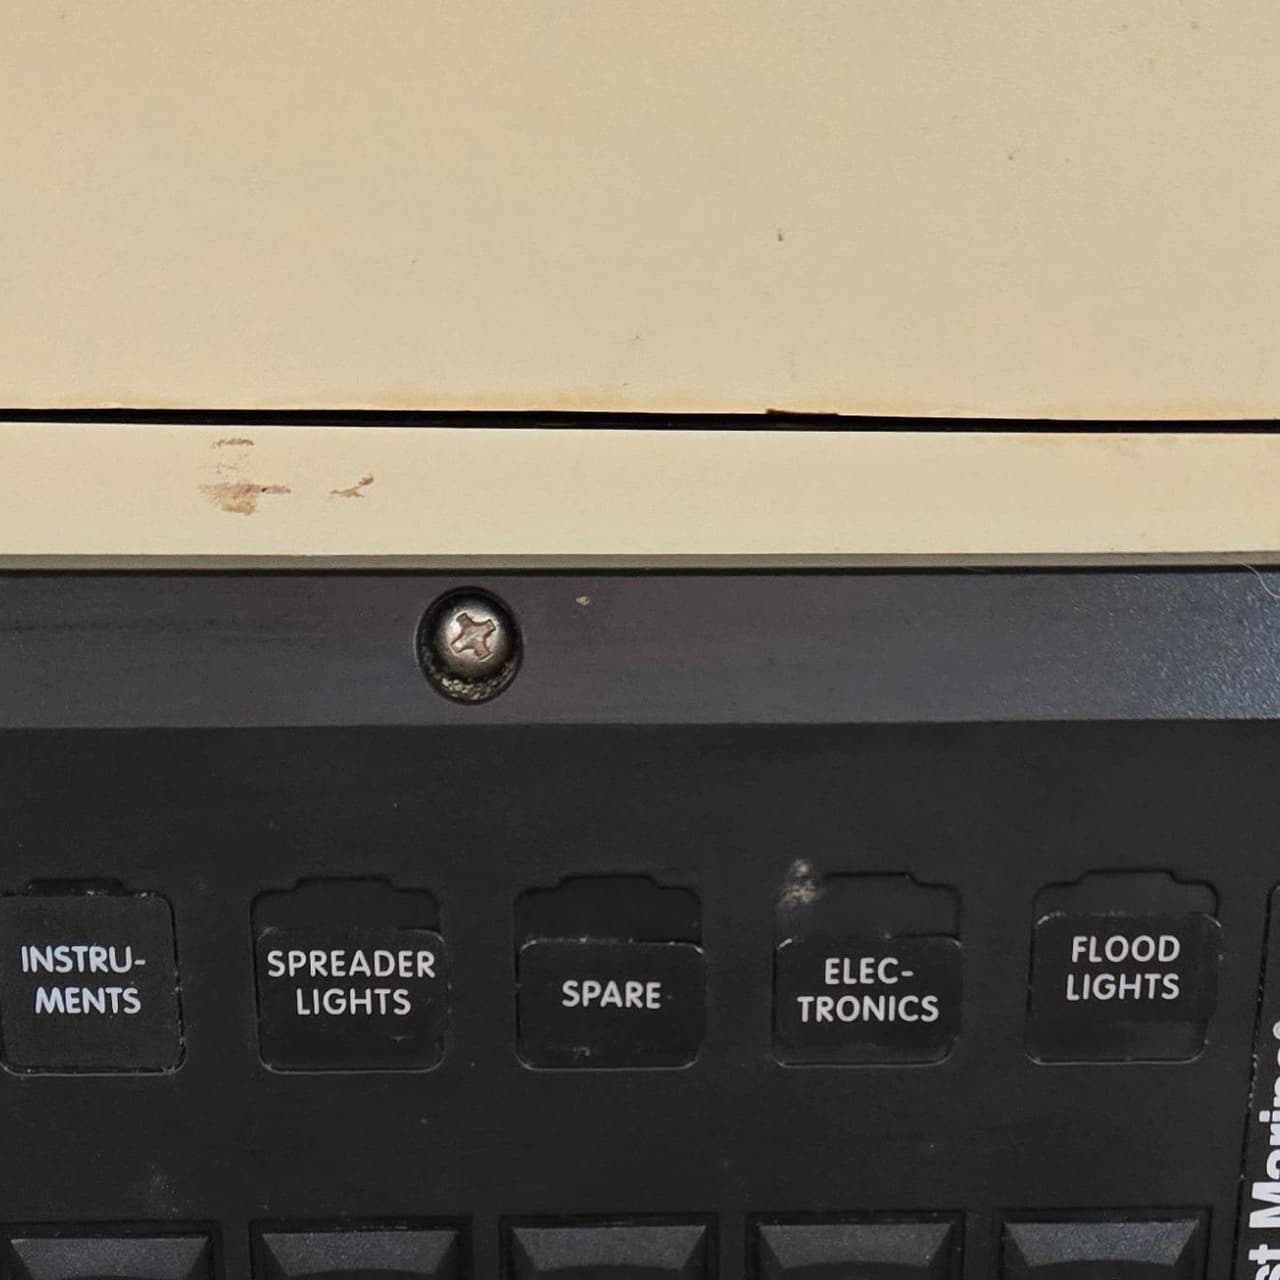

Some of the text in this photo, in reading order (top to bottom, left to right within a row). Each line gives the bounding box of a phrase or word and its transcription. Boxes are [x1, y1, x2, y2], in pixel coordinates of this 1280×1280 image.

[20, 945, 146, 974] INSTRU-
[267, 949, 436, 978] SPREADER
[1071, 935, 1180, 963] FLOOD
[824, 957, 914, 985] ELEC-
[35, 986, 141, 1014] MENTS
[296, 987, 412, 1016] LIGHTS
[562, 980, 661, 1009] SPARE
[1066, 972, 1180, 1002] LIGHTS
[797, 995, 939, 1024] TRONICS
